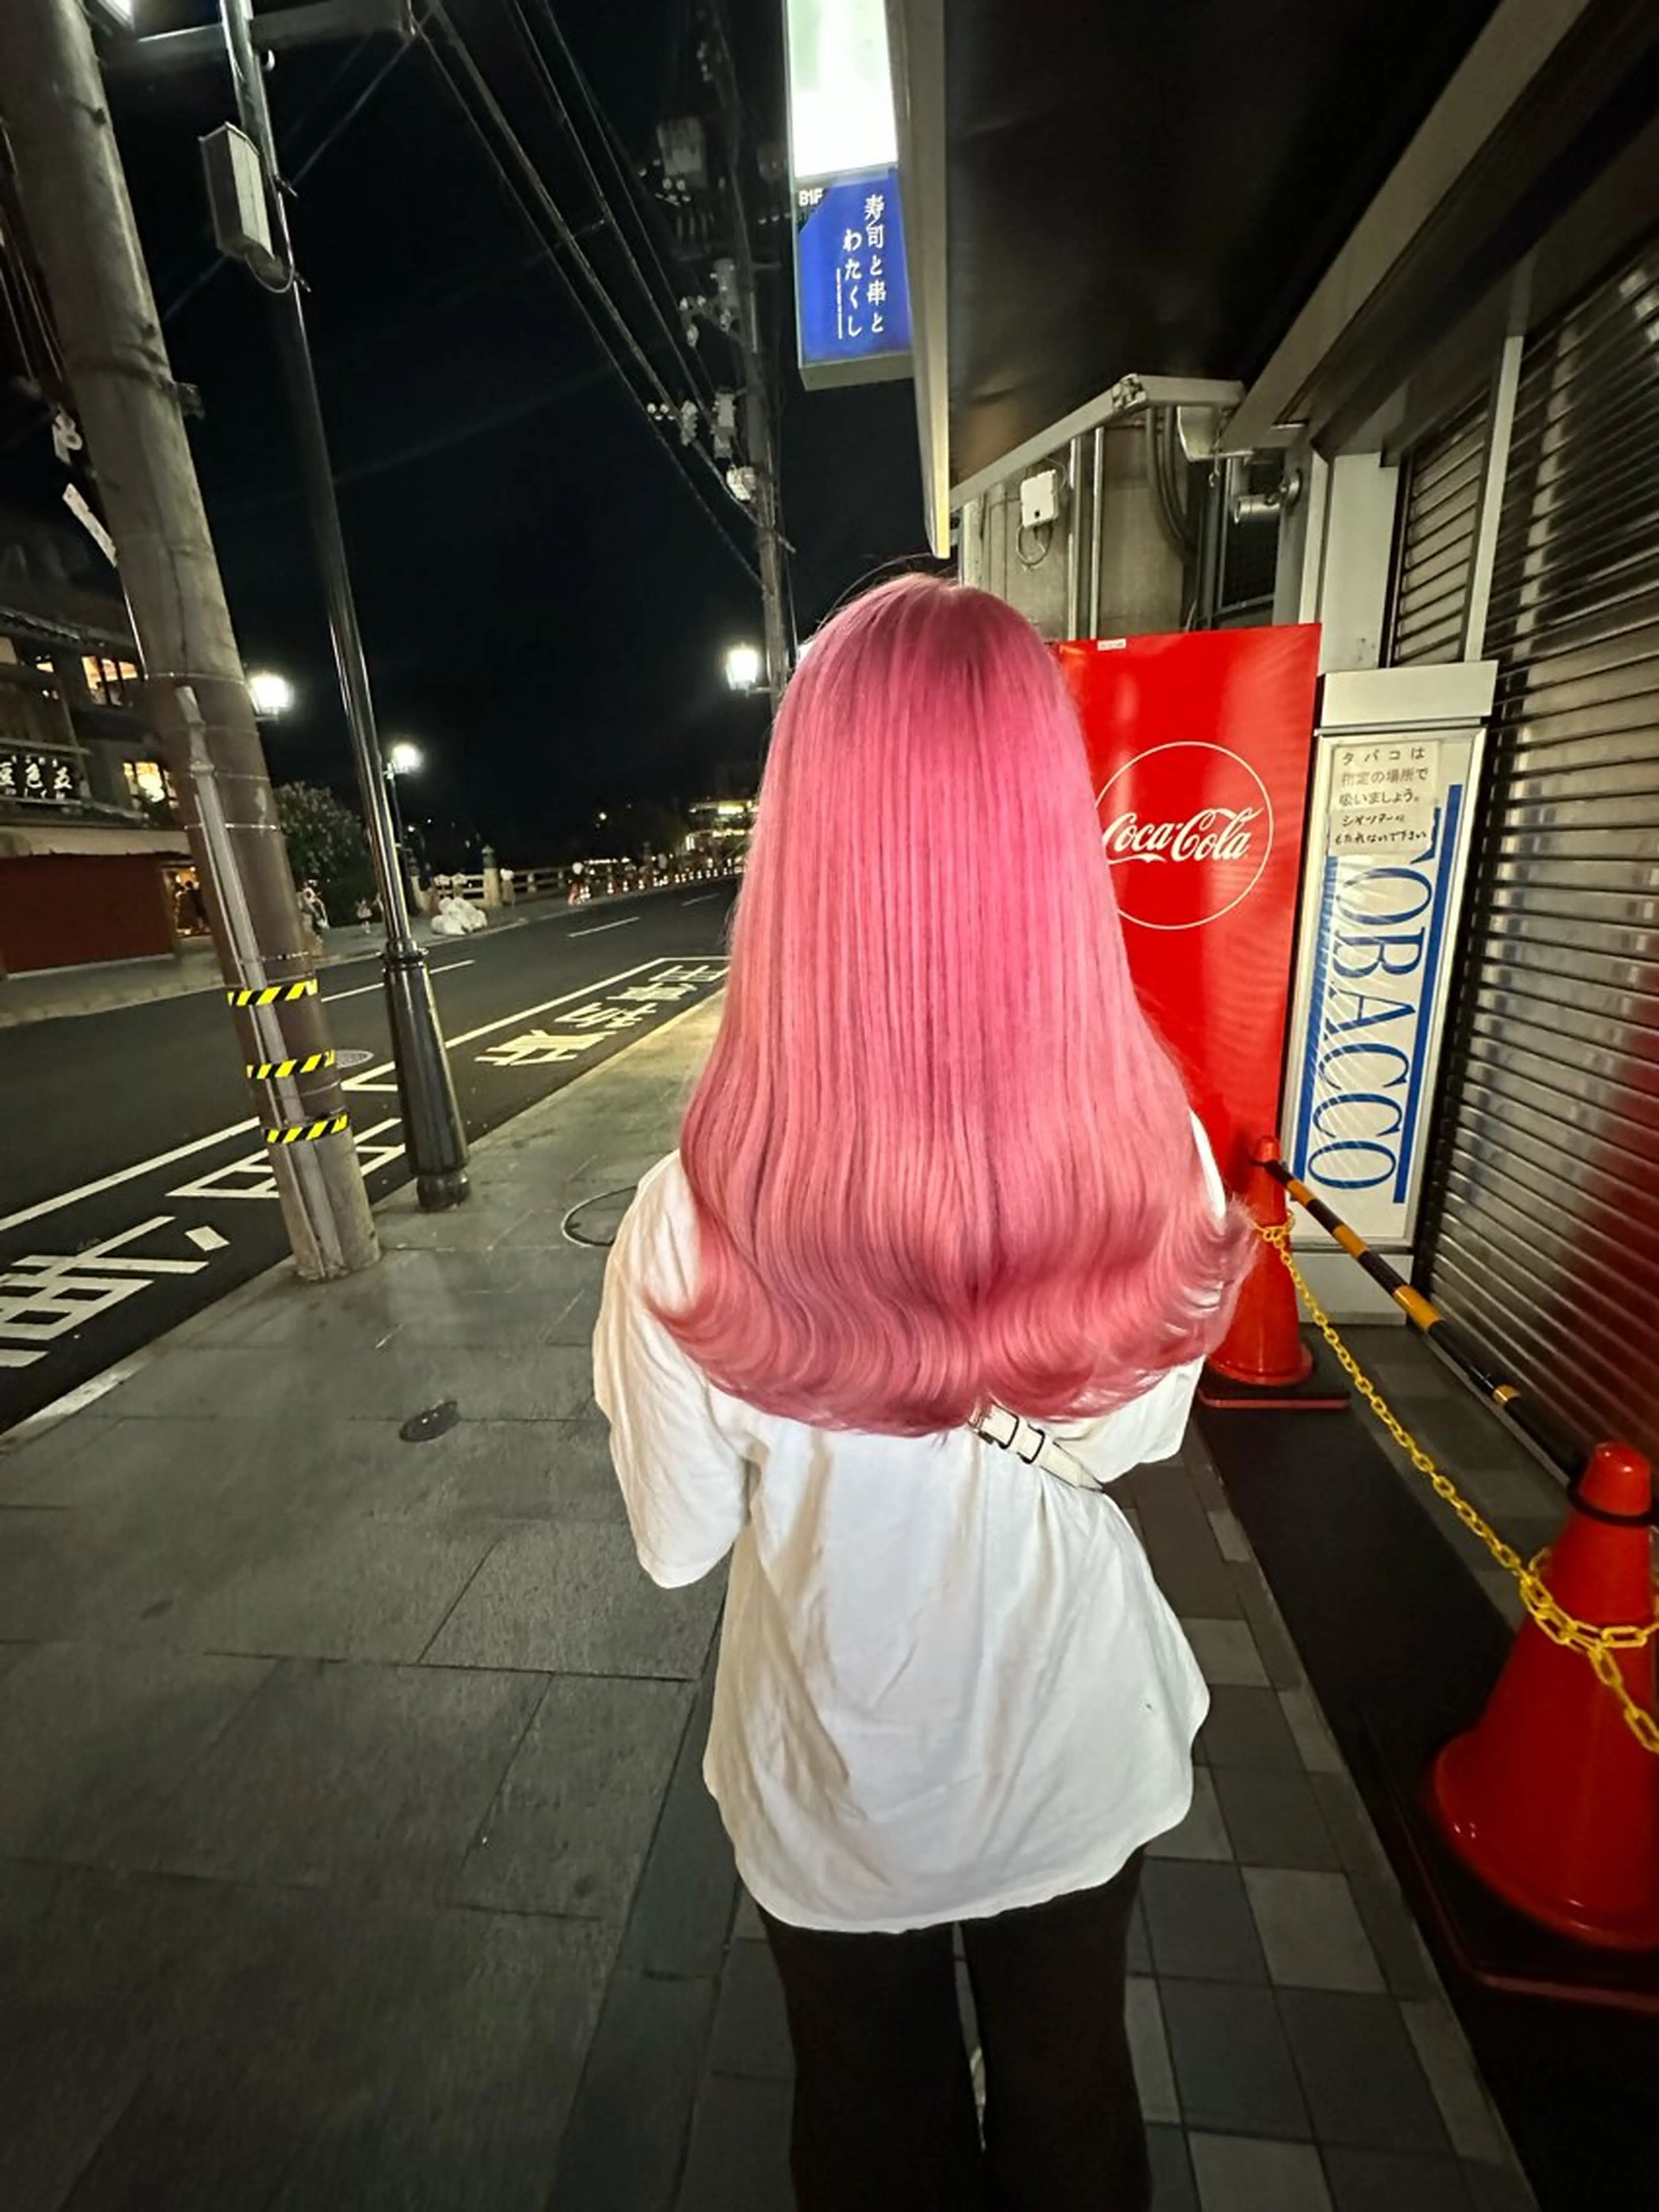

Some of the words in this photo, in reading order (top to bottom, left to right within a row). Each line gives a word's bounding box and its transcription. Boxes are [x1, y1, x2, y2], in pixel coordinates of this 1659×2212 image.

[799, 188, 824, 207] B1F
[864, 194, 886, 334] 寿司と串と
[842, 229, 864, 337] わたくし
[1342, 747, 1426, 766] タバコは
[1341, 767, 1428, 787] 指定の場所で
